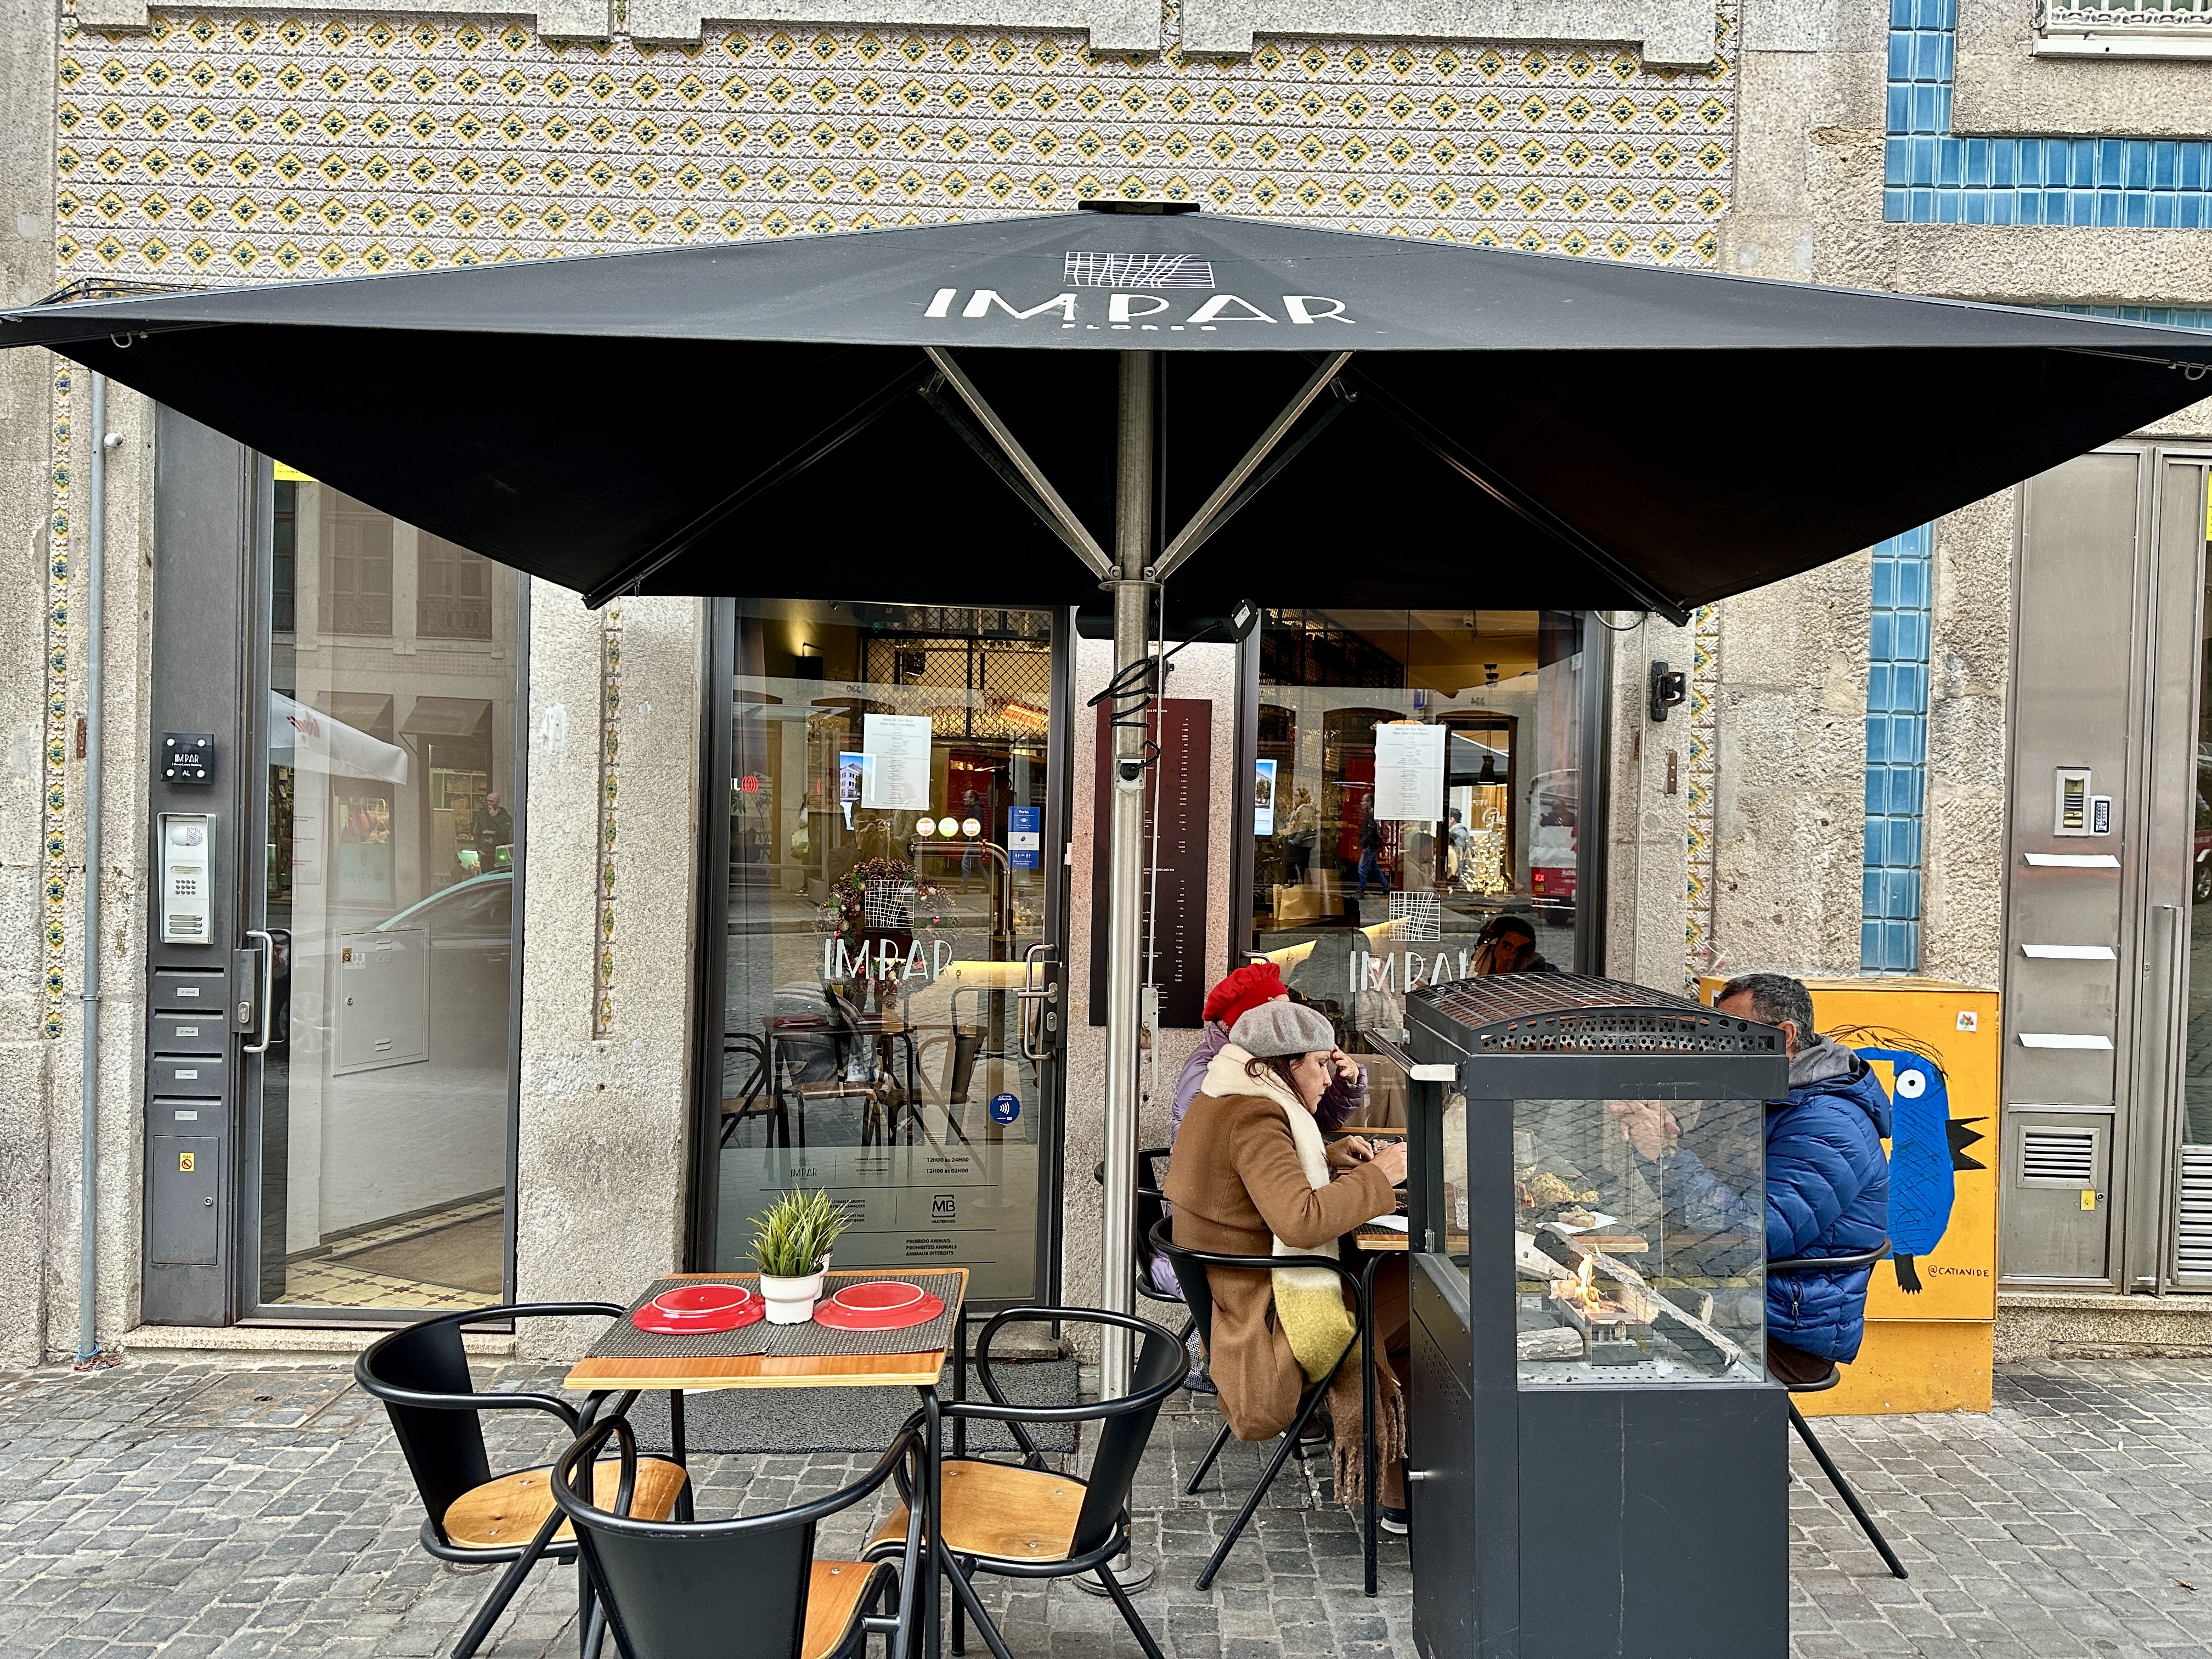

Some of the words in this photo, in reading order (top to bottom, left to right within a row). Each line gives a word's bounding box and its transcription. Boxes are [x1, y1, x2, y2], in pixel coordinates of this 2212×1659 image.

[924, 288, 1356, 325] IMPAR
[174, 754, 199, 763] IMPAR
[791, 1167, 817, 1177] IMPAR
[932, 1200, 956, 1212] MB
[1928, 1265, 1989, 1277] @CATIAVIDE
